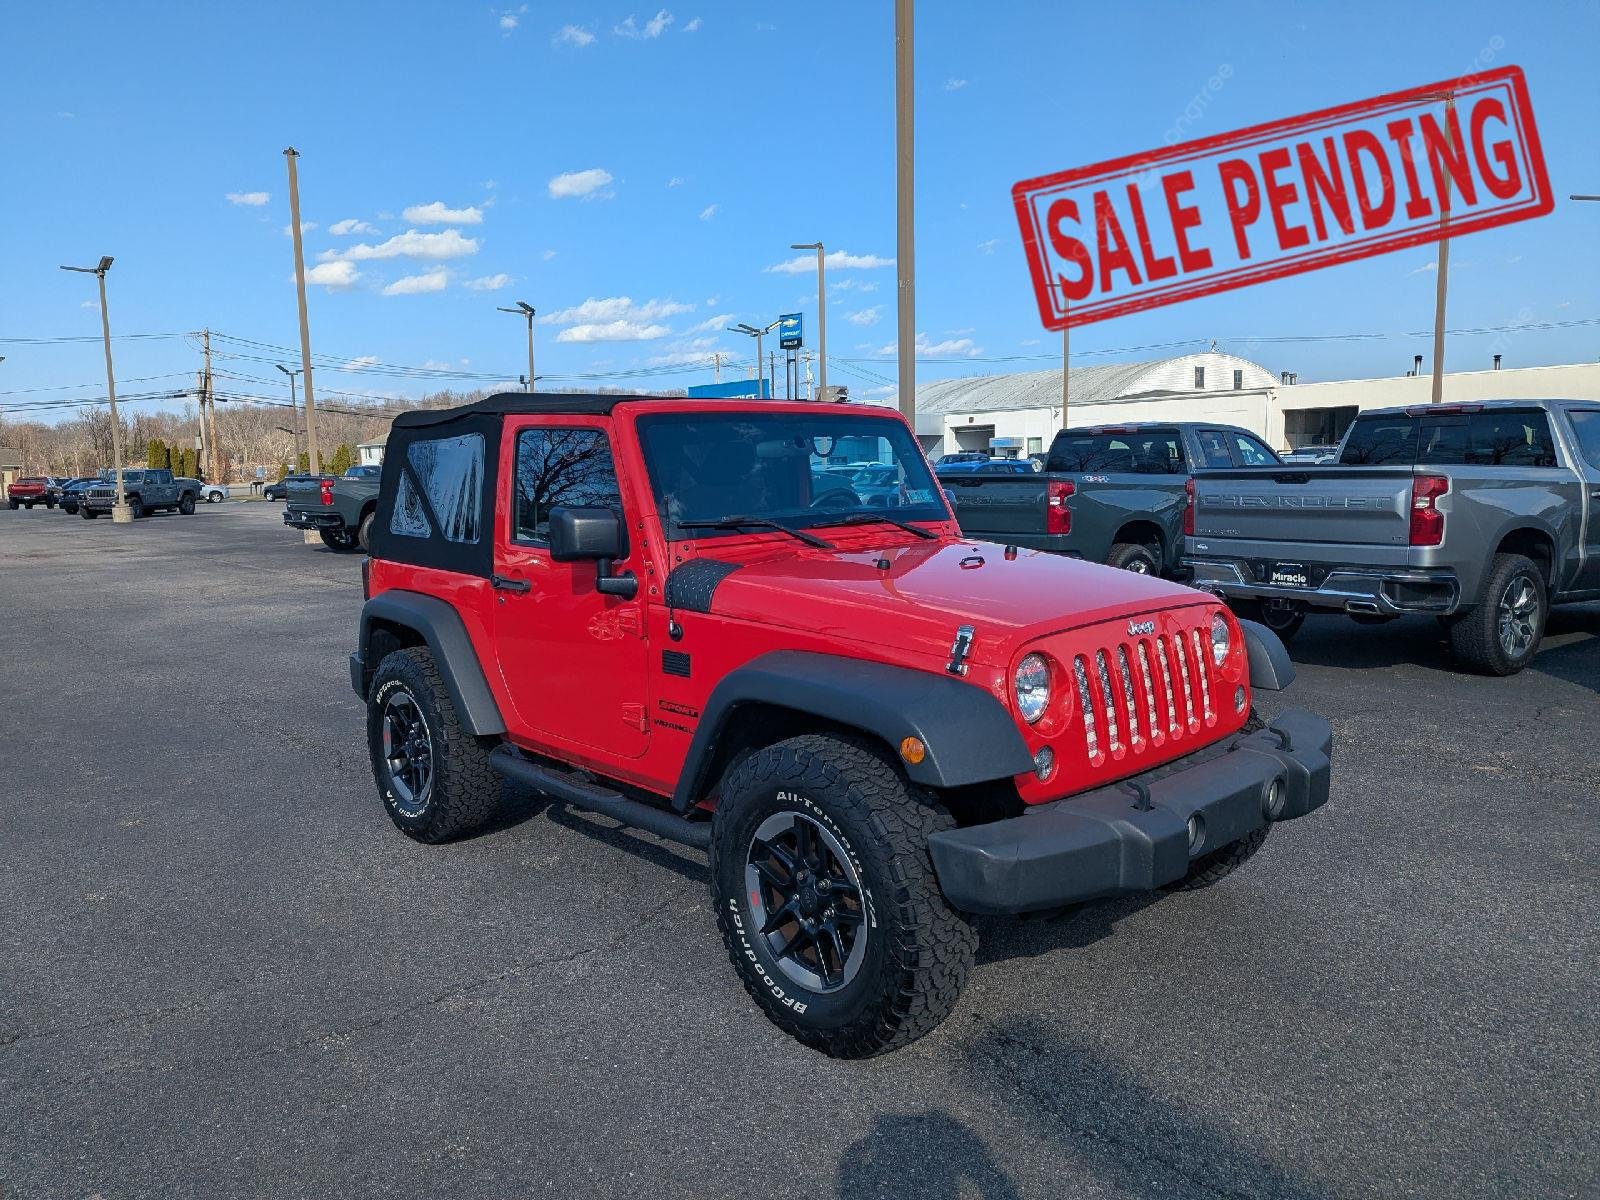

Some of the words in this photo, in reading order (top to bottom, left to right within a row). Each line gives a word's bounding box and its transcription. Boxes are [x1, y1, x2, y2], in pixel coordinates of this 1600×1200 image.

[1201, 494, 1392, 509] CHEVROLET
[1272, 572, 1307, 583] Miracle
[1127, 620, 1155, 636] Jeep
[654, 719, 695, 735] WRANGL
[776, 791, 863, 873] All-Terrain
[729, 898, 808, 1014] BFGoodrich
